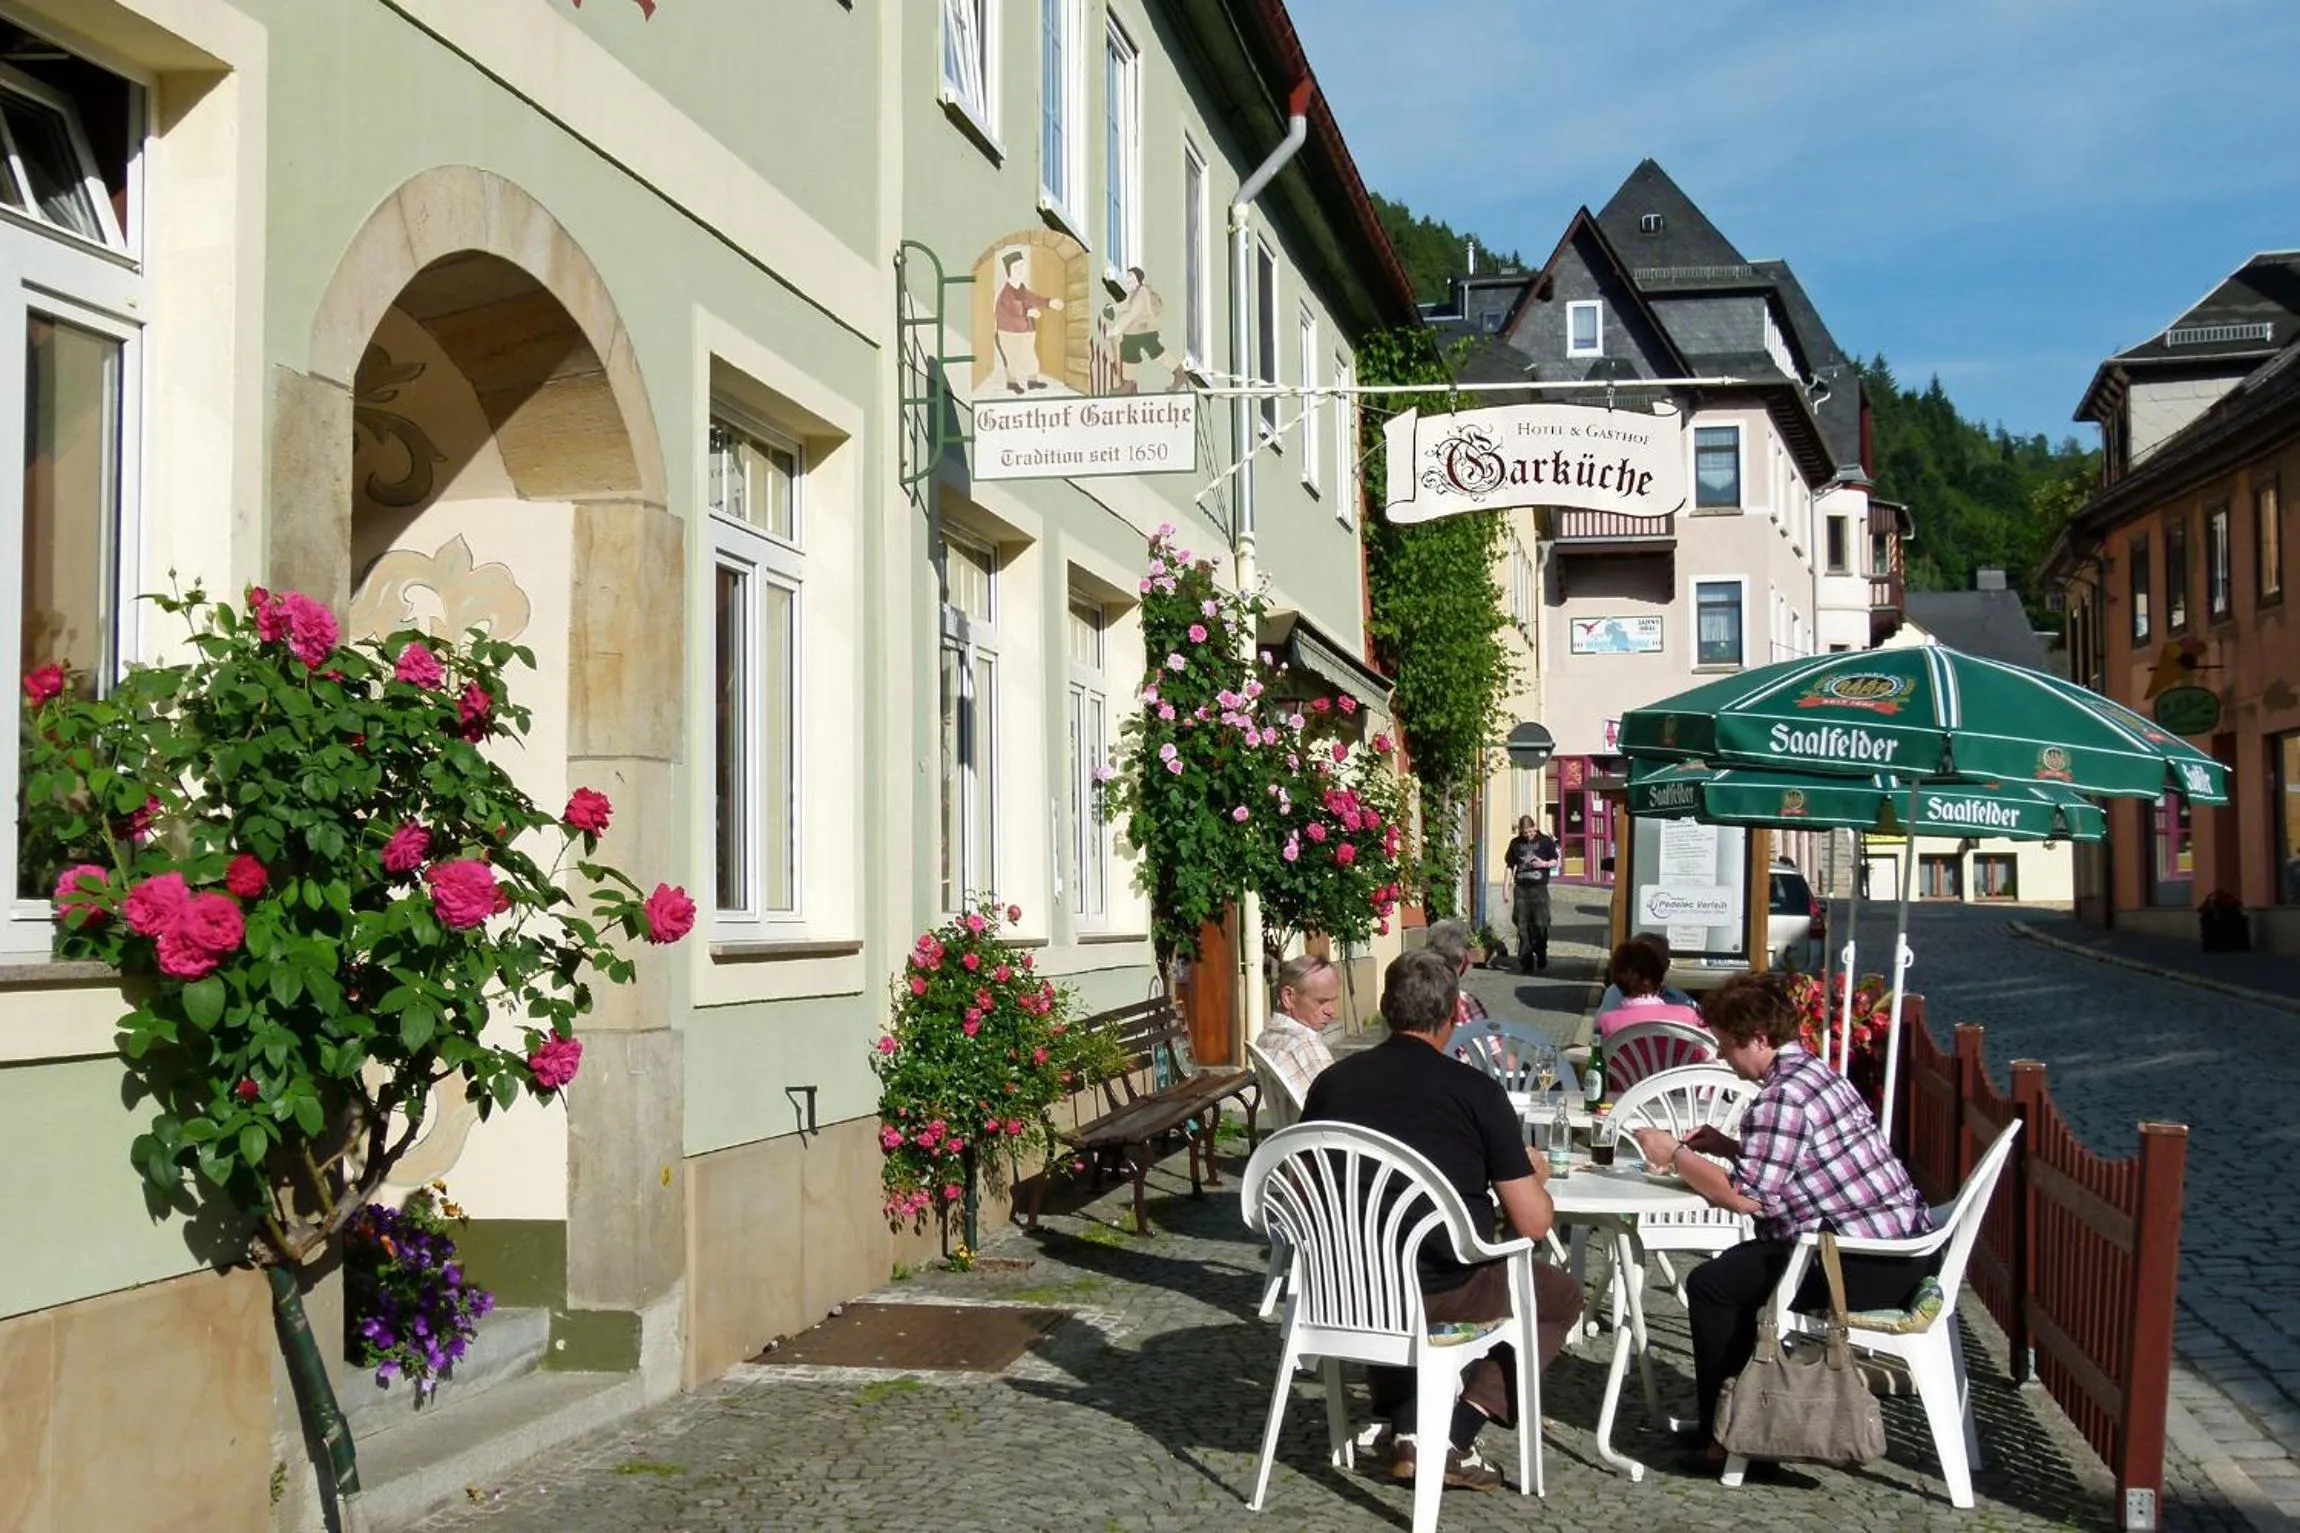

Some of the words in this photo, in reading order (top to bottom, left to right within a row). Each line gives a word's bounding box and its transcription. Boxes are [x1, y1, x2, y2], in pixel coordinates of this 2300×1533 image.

[976, 404, 1073, 434] Gasthof
[1080, 401, 1192, 430] Garküche
[1517, 422, 1563, 436] HOTEL
[1570, 425, 1582, 437] &
[1585, 424, 1651, 446] GASTHOF
[1000, 447, 1084, 467] Tradition
[1089, 444, 1120, 463] seit
[1128, 442, 1168, 462] 1650
[1419, 424, 1654, 501] Garküche
[1768, 722, 1900, 763] Saalfelder
[1927, 795, 2021, 828] Saalfelder
